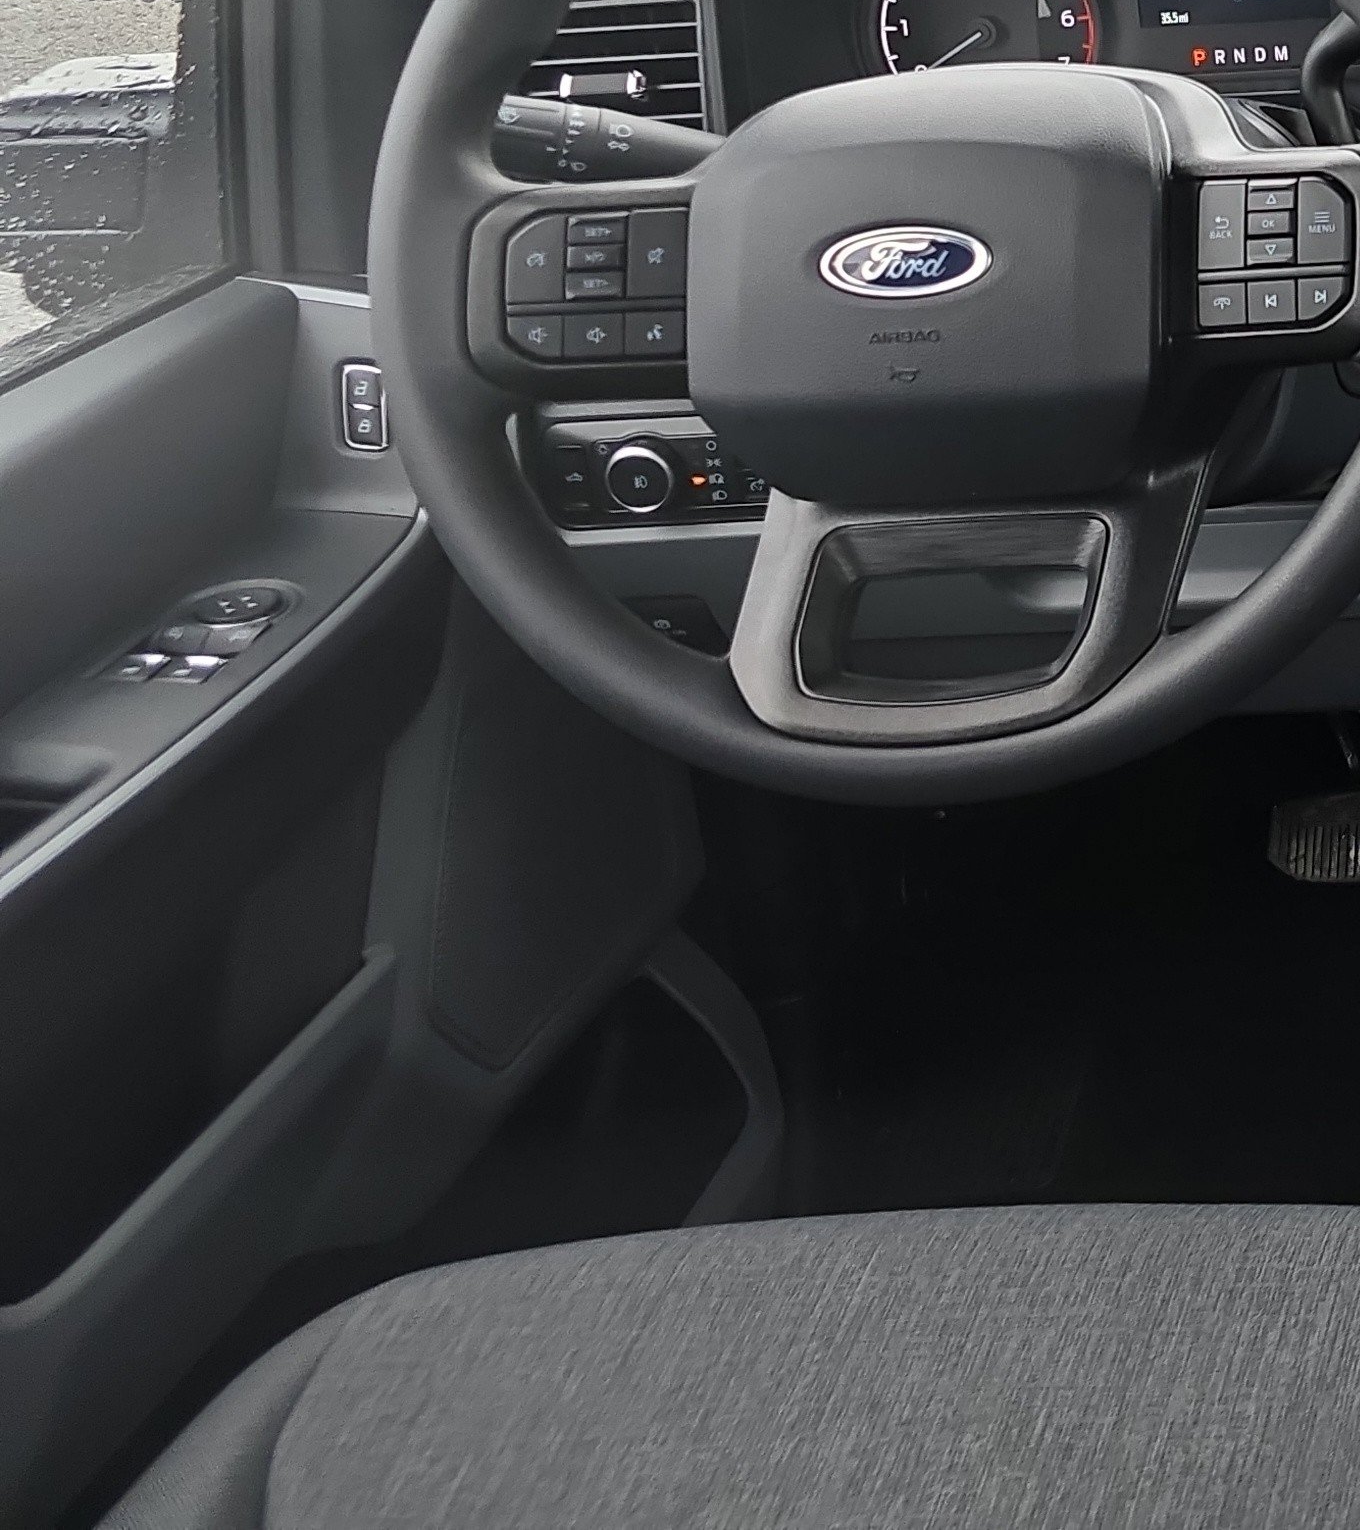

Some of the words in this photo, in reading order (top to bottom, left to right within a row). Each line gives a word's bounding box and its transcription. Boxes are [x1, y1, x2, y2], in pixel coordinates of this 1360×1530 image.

[1060, 10, 1075, 27] 6
[900, 20, 909, 37] 1
[1193, 48, 1206, 66] P
[1214, 50, 1226, 65] R
[1234, 48, 1246, 64] N
[1254, 47, 1267, 62] D
[1274, 45, 1289, 61] M
[1262, 219, 1275, 229] OK
[1308, 224, 1336, 234] MENU
[1209, 230, 1233, 240] BACK
[861, 241, 949, 281] Ford
[869, 329, 940, 345] AIRBAG
